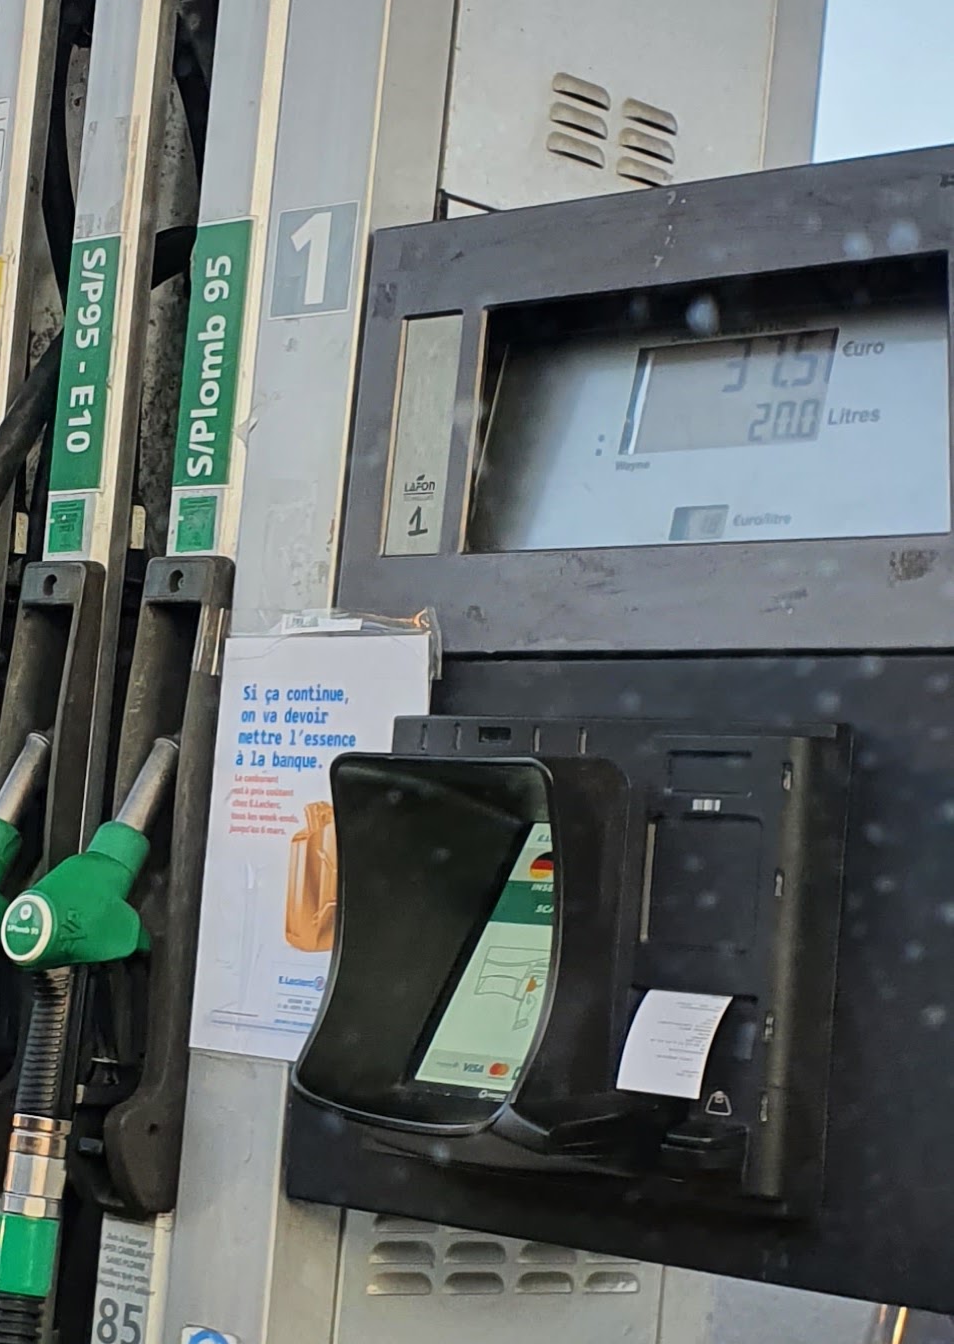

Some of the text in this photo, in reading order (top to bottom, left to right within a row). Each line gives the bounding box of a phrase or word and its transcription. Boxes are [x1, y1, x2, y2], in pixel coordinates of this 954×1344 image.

[290, 212, 331, 305] 1
[203, 254, 232, 301] 95
[75, 247, 107, 348] S/P95
[187, 312, 228, 478] S/Plomb
[66, 384, 94, 454] E10
[827, 407, 881, 426] Litres
[407, 505, 428, 536] 1
[243, 683, 349, 705] Si ça continue,
[241, 706, 329, 724] on va devoir
[237, 729, 357, 747] mettre l'essence
[235, 750, 323, 772] à la banque.
[463, 1062, 485, 1073] VISA
